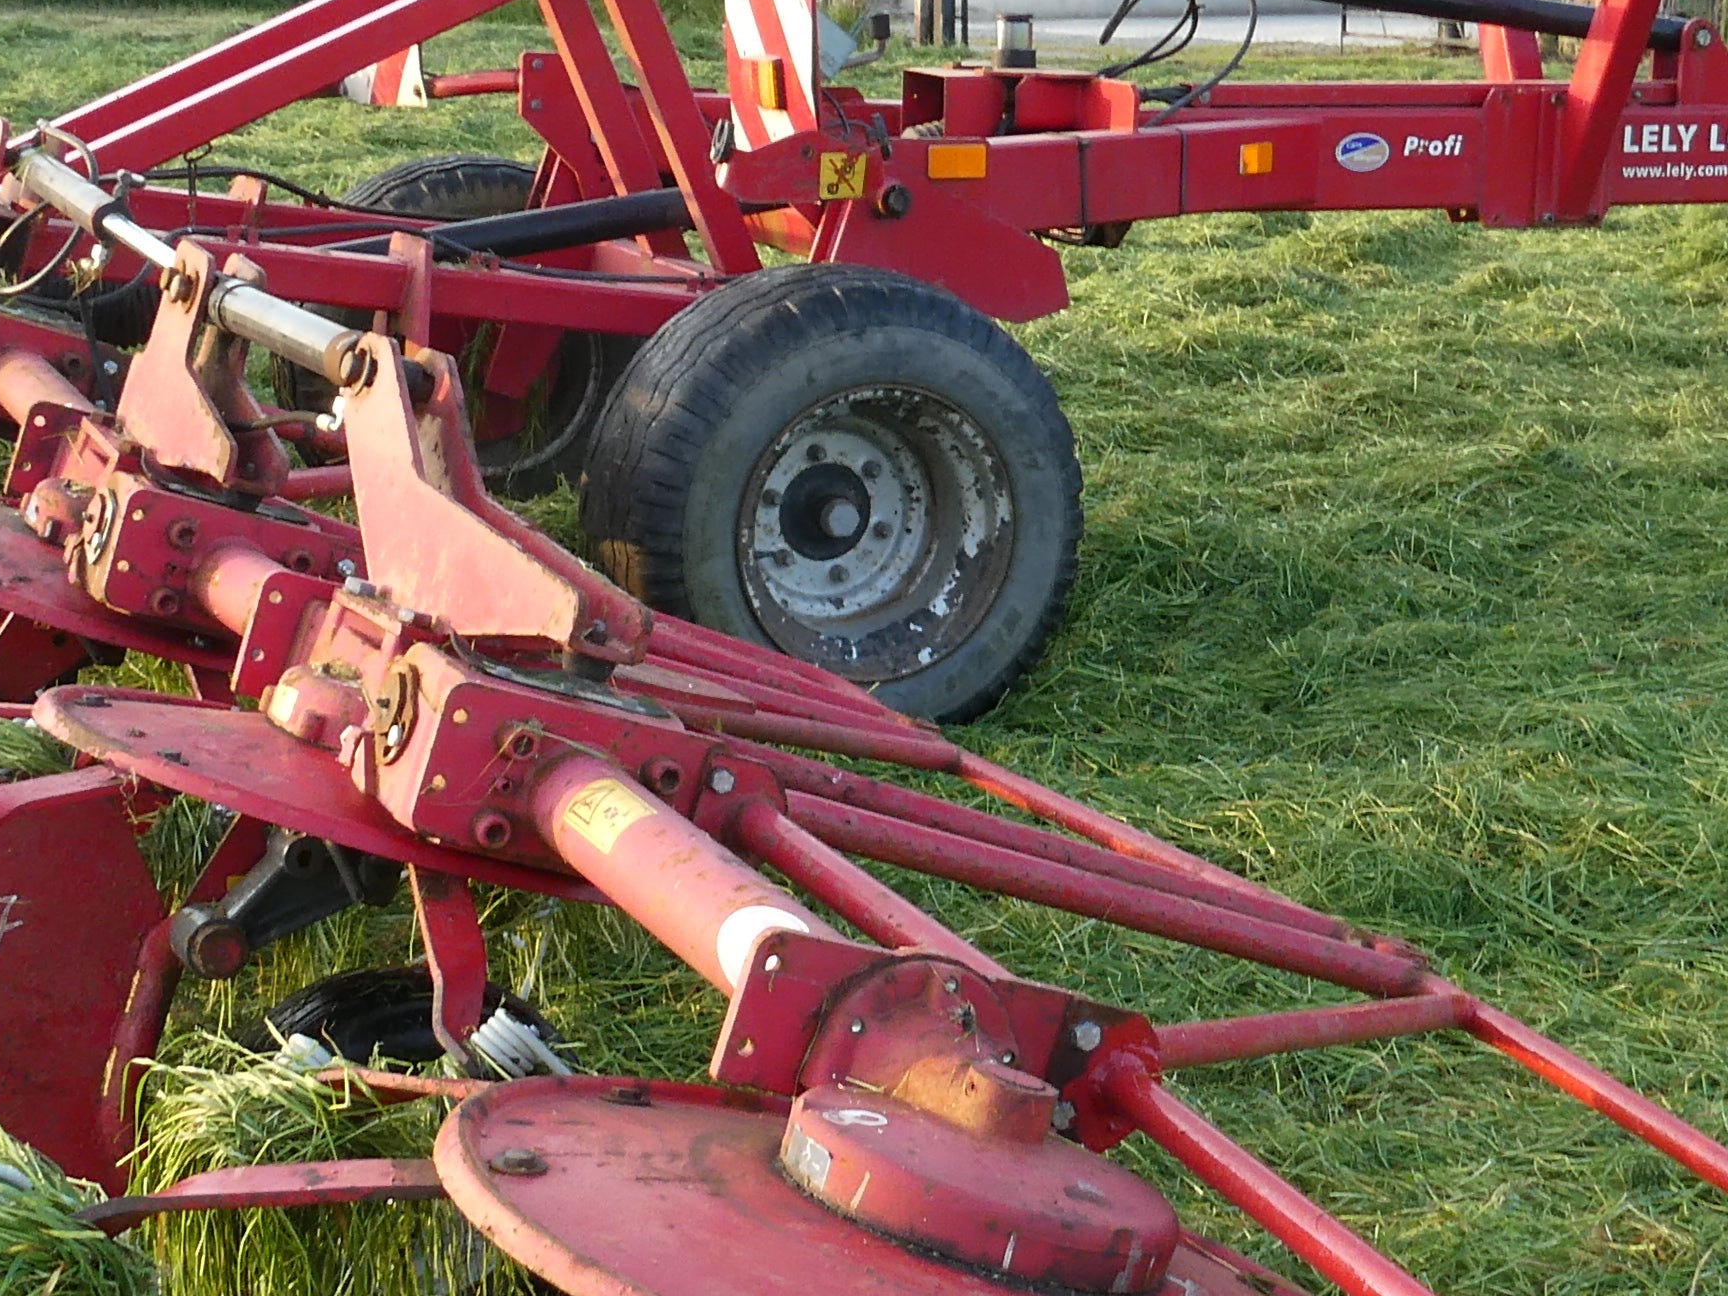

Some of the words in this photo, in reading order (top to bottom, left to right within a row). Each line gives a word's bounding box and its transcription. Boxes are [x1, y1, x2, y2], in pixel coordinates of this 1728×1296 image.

[1403, 133, 1464, 157] Profi
[1623, 124, 1698, 153] LELY
[1622, 161, 1728, 180] www.lely.com
